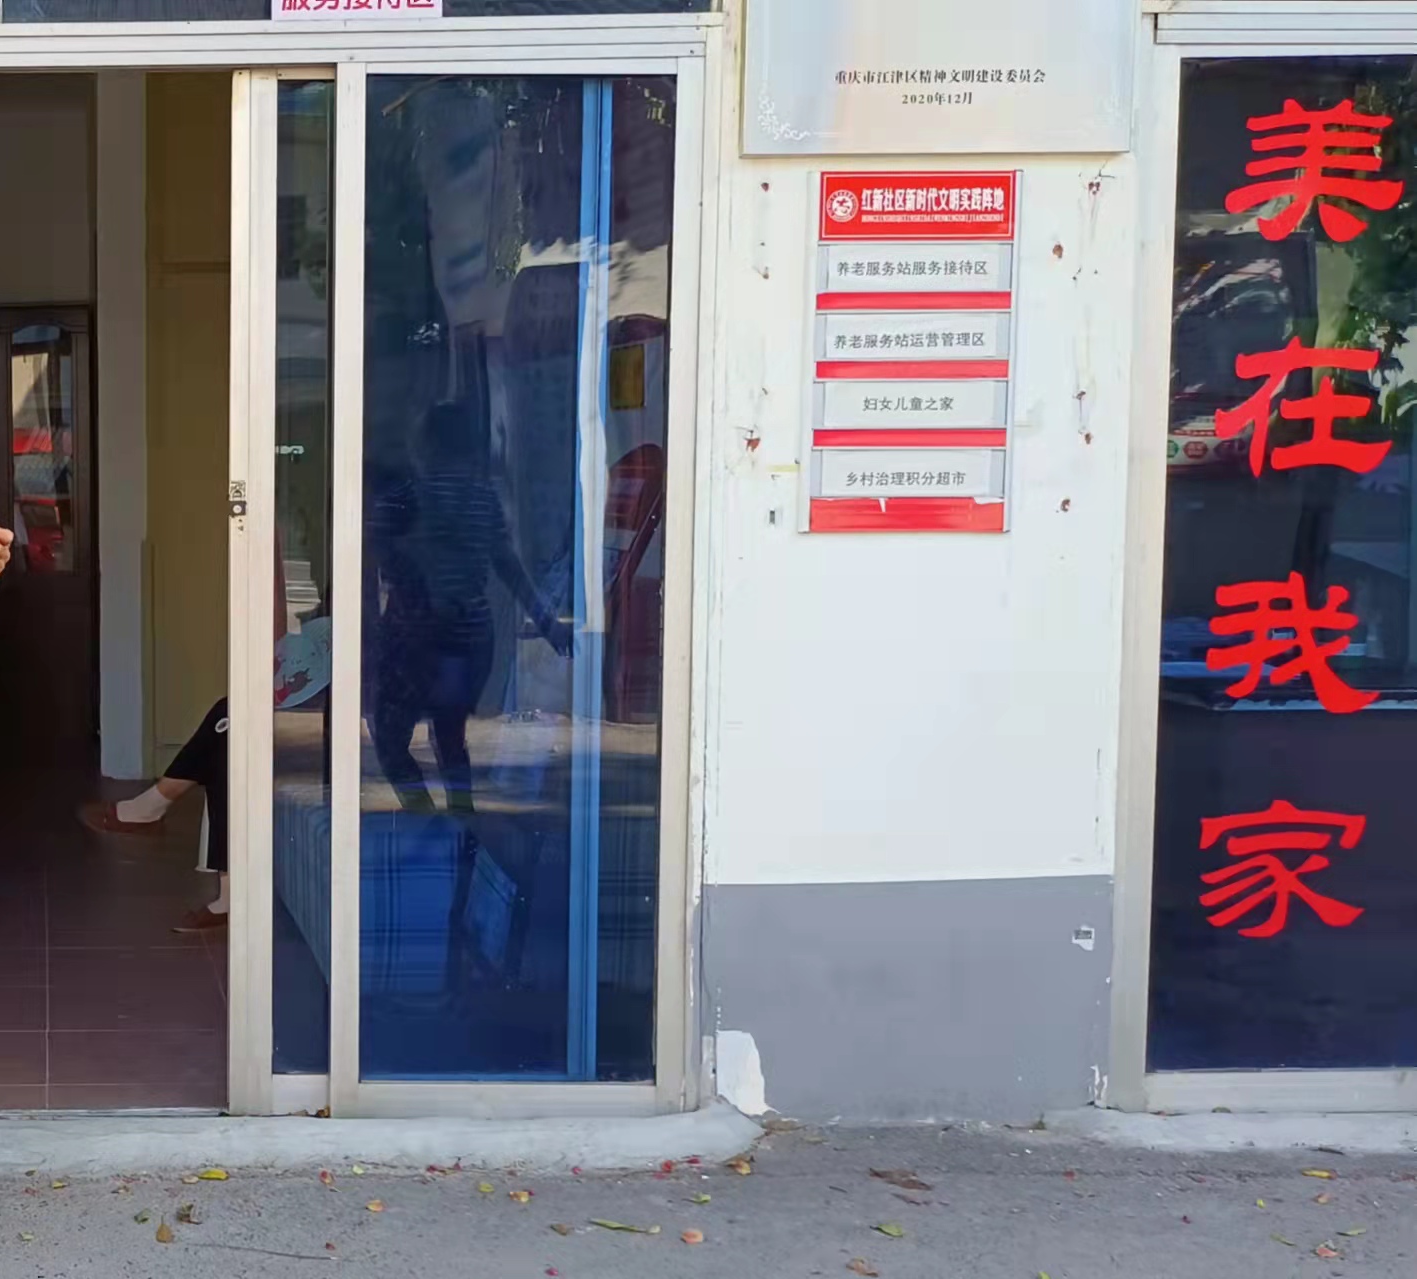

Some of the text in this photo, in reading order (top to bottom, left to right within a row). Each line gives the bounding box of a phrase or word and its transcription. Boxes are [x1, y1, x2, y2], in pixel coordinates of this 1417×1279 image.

[835, 69, 1047, 84] 重庆市江津区精神文明建设委员会
[901, 92, 973, 105] 2020年12月
[861, 188, 1004, 211] 红新社区新时代文明实践阵地
[837, 261, 989, 276] 养老服务站服务接待区
[834, 332, 985, 349] 养老服务站运营管理区
[863, 396, 954, 411] 妇女儿童之家
[845, 470, 966, 487] 乡村治理积分超市
[1198, 99, 1404, 938] 美在我家
